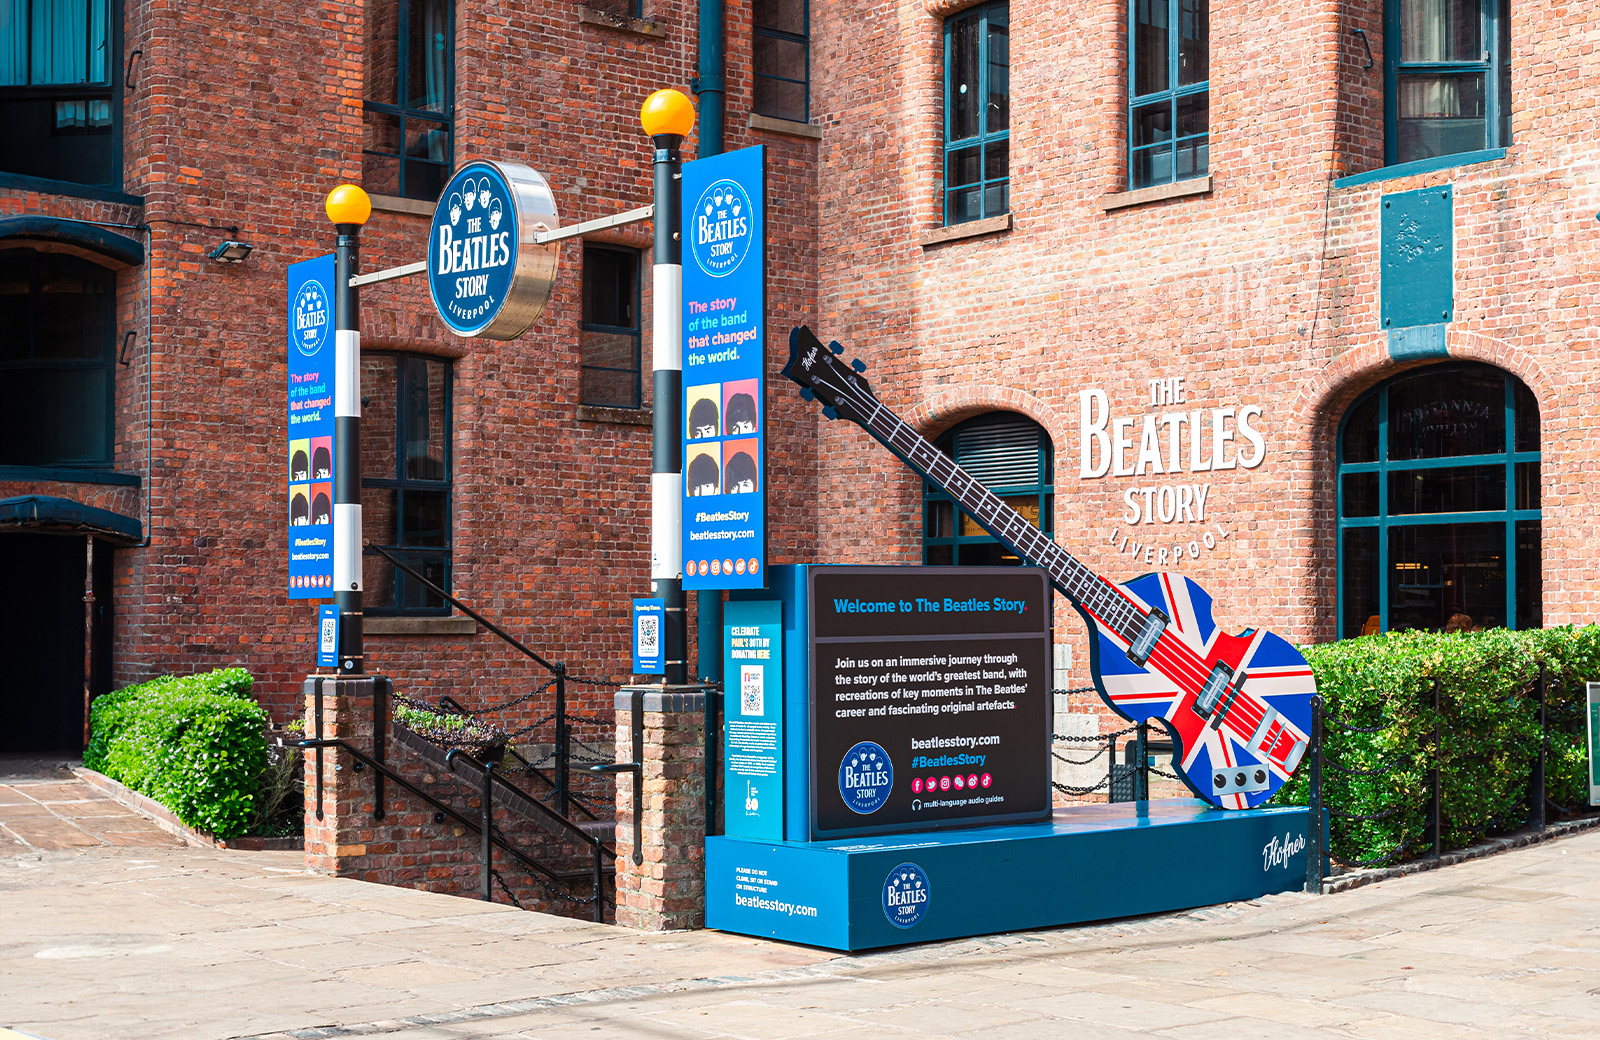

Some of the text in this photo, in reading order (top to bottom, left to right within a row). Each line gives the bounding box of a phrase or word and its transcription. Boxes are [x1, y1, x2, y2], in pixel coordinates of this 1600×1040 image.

[717, 209, 728, 221] THE
[467, 216, 482, 234] THE
[698, 215, 747, 245] BEATLES
[437, 223, 510, 275] BEATLES
[710, 241, 734, 258] STORY
[706, 253, 739, 269] LIVERPOOL
[455, 273, 490, 299] STORY
[448, 295, 495, 320] LIVERPOOL
[688, 297, 737, 315] The story
[296, 306, 326, 330] BEATLES
[688, 310, 748, 332] of the band
[303, 328, 318, 341] STORY
[688, 326, 757, 349] that changed
[688, 347, 741, 367] the world.
[290, 371, 320, 384] The story
[290, 382, 326, 398] of the band
[1148, 376, 1185, 407] THE
[290, 395, 332, 411] that changed
[290, 411, 322, 425] the world.
[1079, 388, 1266, 479] BEATLES
[1123, 482, 1210, 526] STORY
[695, 510, 750, 523] #BeatlesStory
[295, 537, 327, 547] #BeatlesStory
[689, 529, 755, 541] beatlesstory.com
[1108, 523, 1230, 565] LIVERPOOL
[291, 552, 330, 561] beatlesstory.com
[833, 597, 1028, 614] Welcome to The Beatles Story.
[731, 626, 760, 636] CELEBRATE
[763, 638, 770, 648] BY
[731, 649, 771, 660] DONATING HERE
[834, 653, 1018, 669] Join us on an immersive journey through
[835, 667, 1027, 686] the story of the world's greatest band, with
[835, 683, 1028, 702] recreations of key moments in The Beatles'
[835, 700, 1017, 718] career and fascinating original artefacts.
[911, 734, 1001, 750] beatlesstory.com
[862, 763, 871, 771] THE
[911, 753, 987, 769] #BeatlesStory
[845, 766, 889, 789] BEATLES
[856, 788, 877, 799] STORY
[745, 797, 759, 811] 80
[852, 797, 881, 808] LIVERPOOL
[923, 795, 1005, 809] multi-language audio guides
[736, 867, 751, 875] PLEASE
[743, 884, 768, 893] STRUCTURE
[887, 885, 927, 907] BEATLES
[735, 893, 818, 917] beatlesstory.com
[897, 905, 916, 916] STORY
[894, 913, 920, 924] LIVERPOOL
